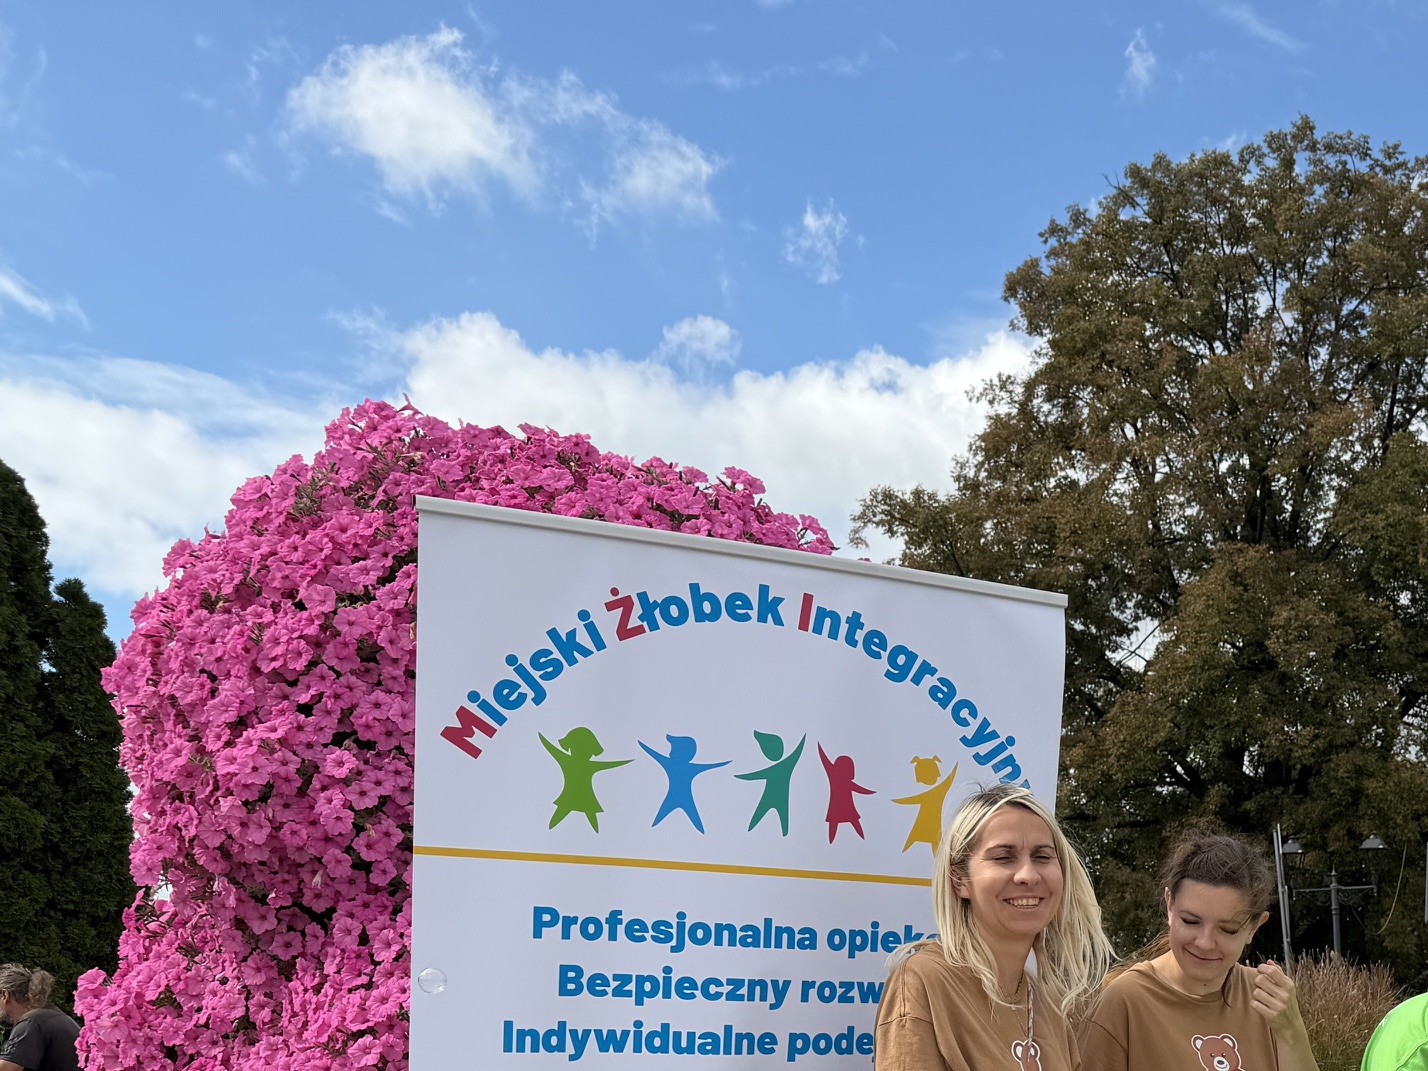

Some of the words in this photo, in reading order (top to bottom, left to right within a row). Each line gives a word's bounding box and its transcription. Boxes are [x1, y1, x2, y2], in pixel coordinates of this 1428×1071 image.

[440, 608, 606, 759] Miejski
[604, 582, 786, 642] Żłobek
[797, 592, 1031, 790] Integracyjn
[532, 906, 817, 953] Profesjonalna
[826, 920, 941, 959] opiek
[558, 963, 792, 1011] Bezpieczny
[501, 1020, 778, 1062] Indywidualne
[787, 1026, 875, 1062] pode
